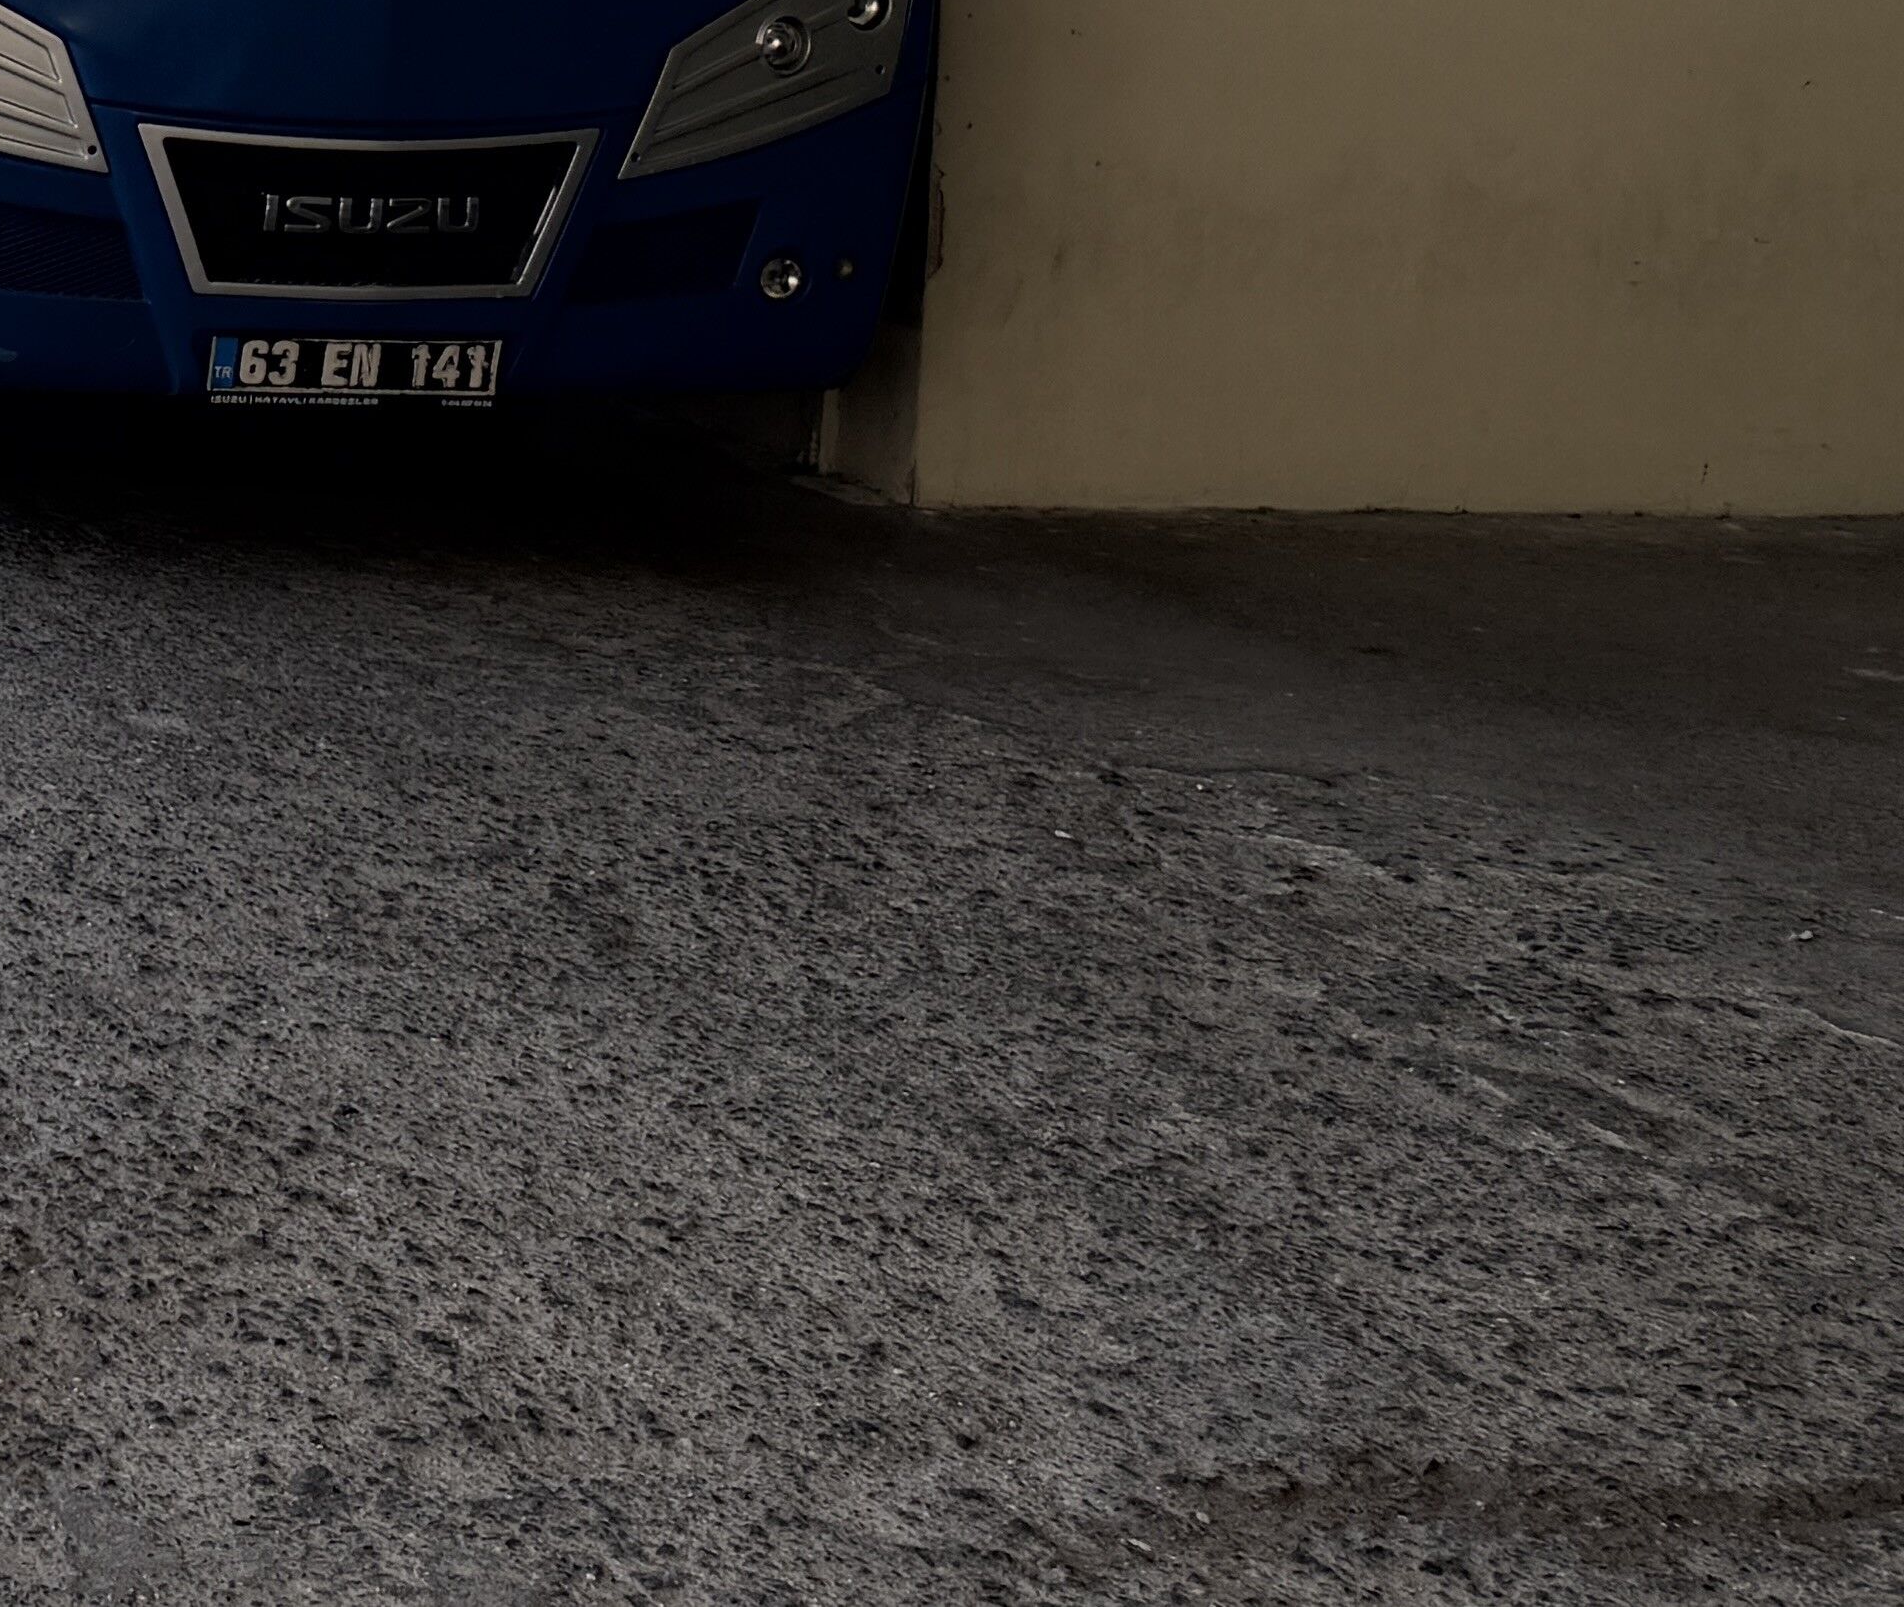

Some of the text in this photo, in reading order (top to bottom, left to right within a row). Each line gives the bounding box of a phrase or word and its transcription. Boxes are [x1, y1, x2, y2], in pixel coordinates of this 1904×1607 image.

[263, 193, 480, 234] ISUZU
[214, 366, 233, 379] TR
[239, 339, 490, 389] 63 EN 141
[210, 394, 247, 404] ISUZU
